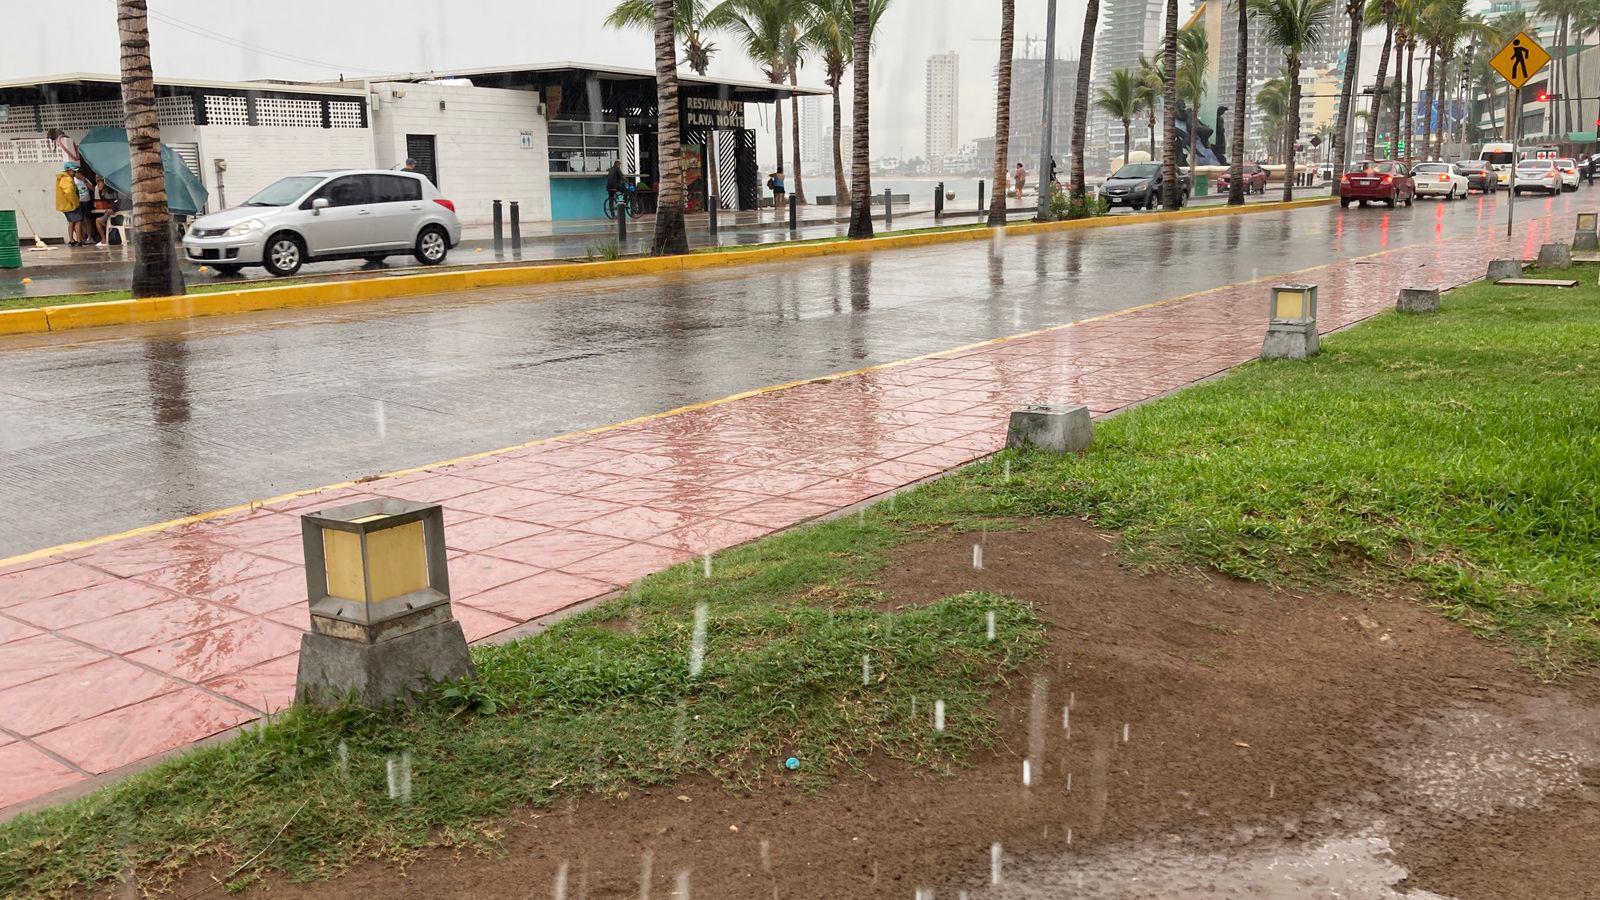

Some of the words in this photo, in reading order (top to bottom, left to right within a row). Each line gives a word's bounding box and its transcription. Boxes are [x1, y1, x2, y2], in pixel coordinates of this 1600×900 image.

[688, 98, 743, 112] RESTAURANTE
[688, 113, 714, 126] PLAYA
[717, 115, 745, 127] NORTE
